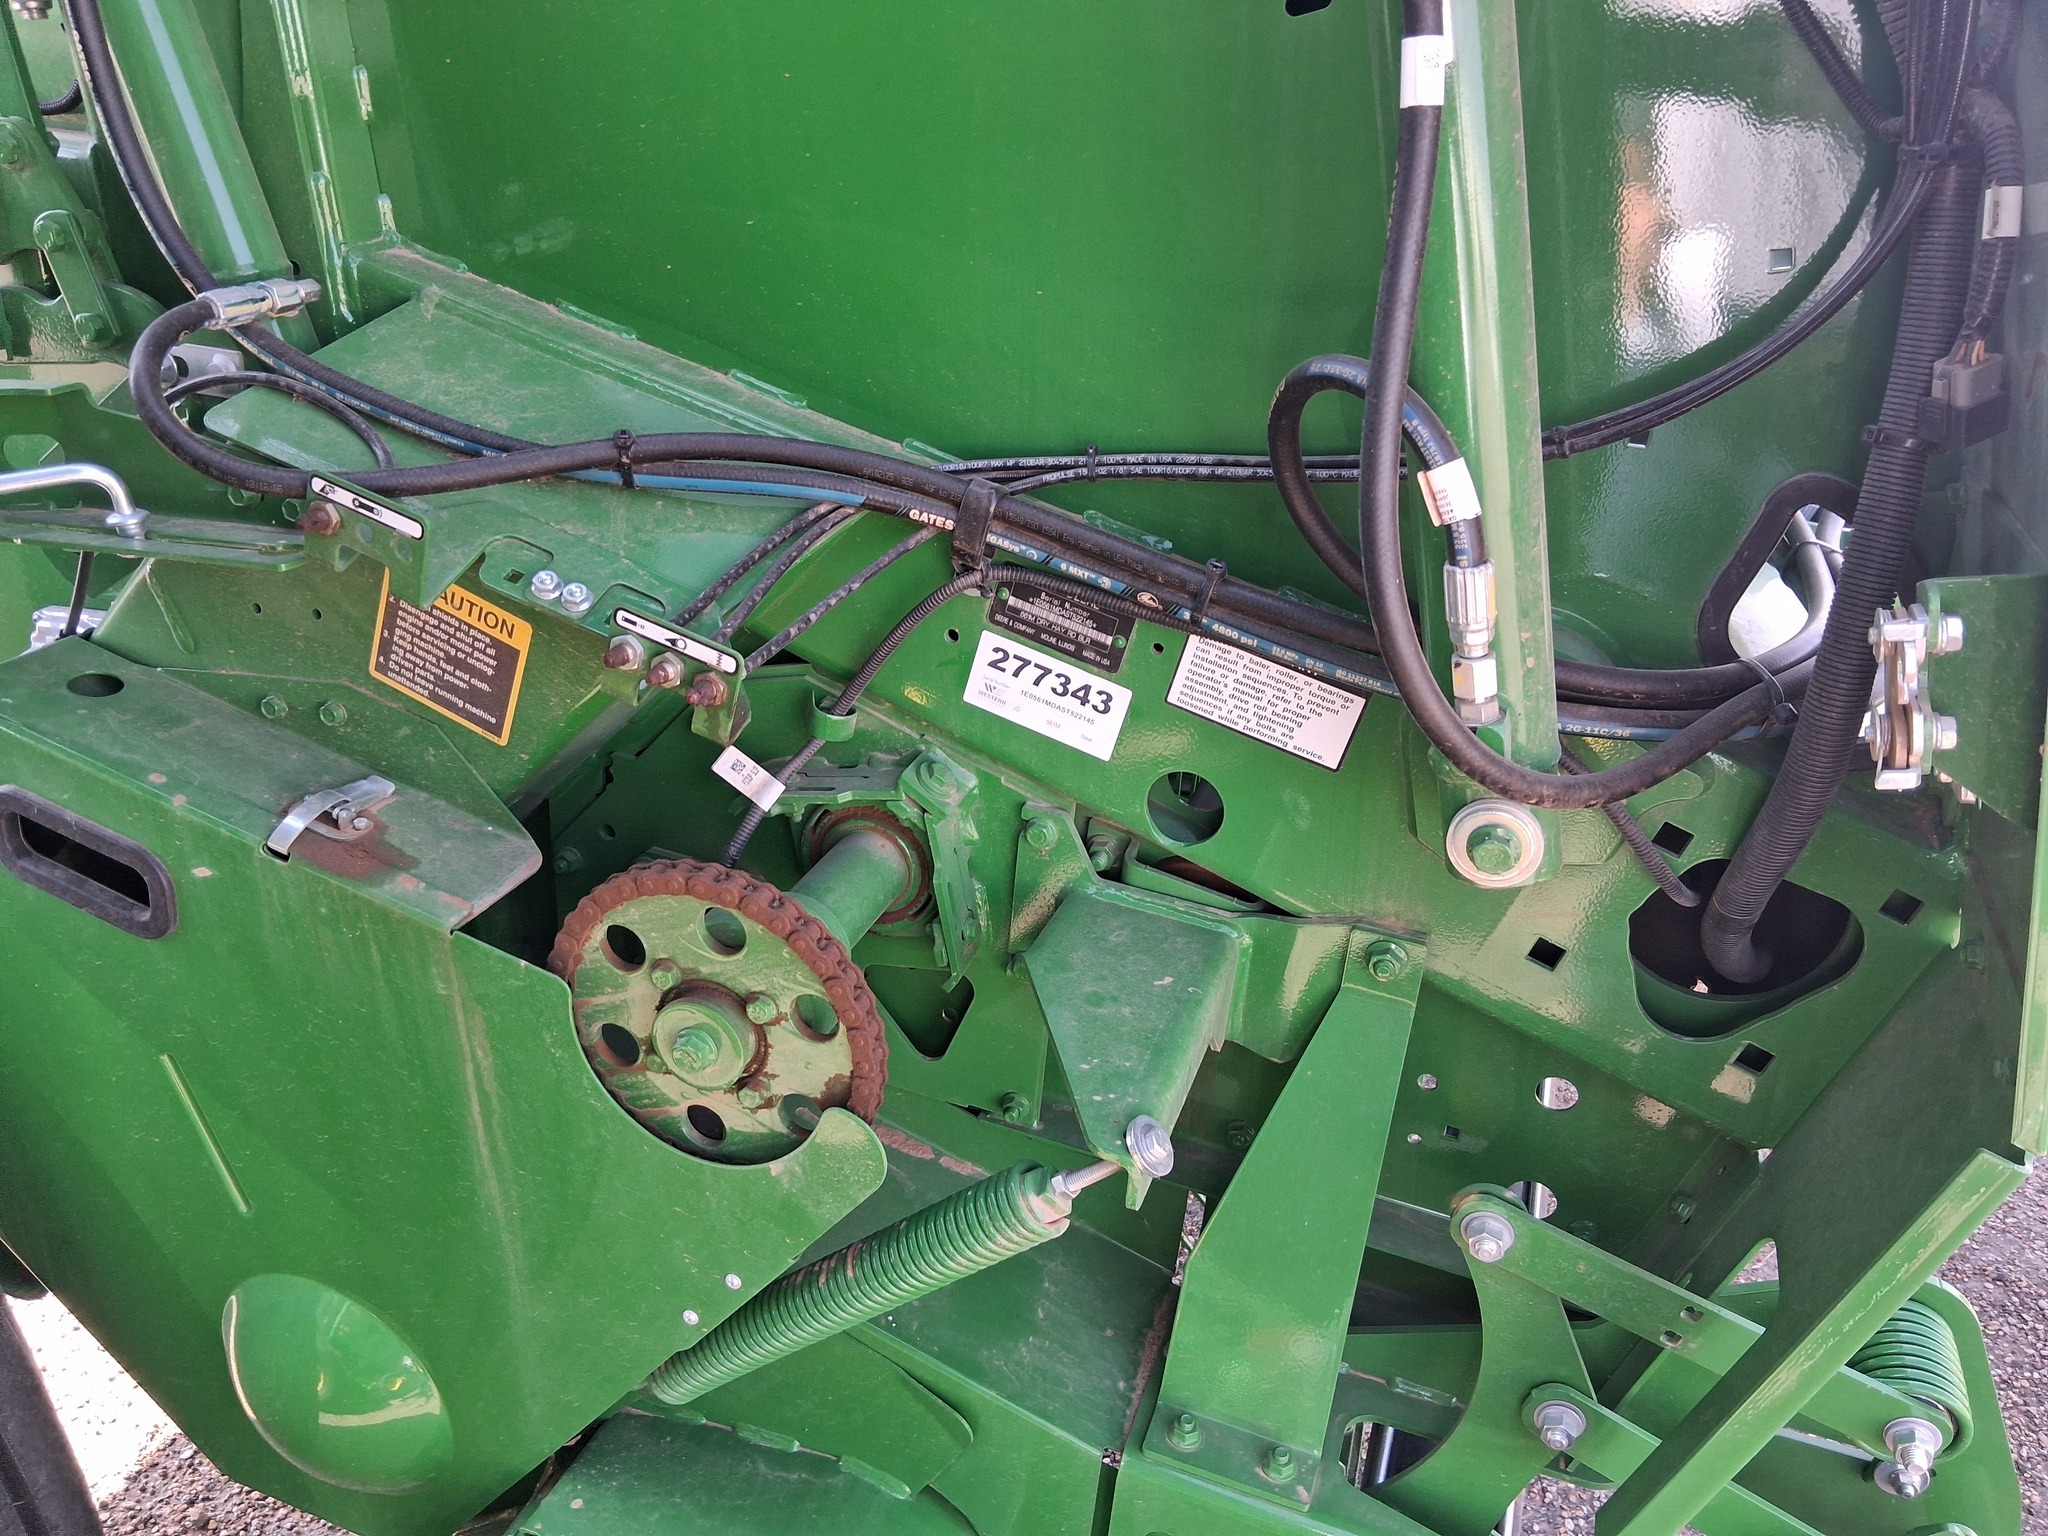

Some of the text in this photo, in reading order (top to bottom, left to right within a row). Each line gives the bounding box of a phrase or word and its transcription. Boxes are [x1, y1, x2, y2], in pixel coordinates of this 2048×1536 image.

[1126, 455, 1144, 463] MADE
[1130, 466, 1143, 474] SAE
[1198, 468, 1213, 476] MAX
[908, 508, 956, 531] GATES
[399, 599, 439, 626] Disengage
[439, 622, 455, 635] and
[455, 630, 473, 645] shut
[473, 640, 486, 651] off
[485, 646, 496, 657] all
[431, 608, 492, 645] shields in place.
[440, 591, 515, 639] AUTION
[1035, 616, 1051, 628] DRY
[1050, 623, 1067, 635] HAY
[1066, 628, 1077, 639] RD
[1040, 591, 1061, 606] Serial
[1063, 601, 1090, 617] Number
[394, 627, 446, 659] ging machine.
[396, 617, 495, 676] before servicing or unclog-
[397, 609, 498, 667] engine and/or motor power
[994, 612, 1009, 625] DEERE
[1013, 621, 1036, 635] COMPANY
[1081, 649, 1096, 660] MADE
[1094, 654, 1101, 662] IN
[1100, 657, 1111, 666] USA
[1211, 623, 1239, 640] 4800
[382, 628, 492, 692] 3. Keep hands, feet and cloth-
[387, 670, 430, 698] unattended.
[389, 653, 436, 682] driven parts.
[391, 643, 470, 689] ing away from power-
[988, 647, 1112, 714] 277343
[1192, 652, 1340, 716] installation sequences. To prevent
[1194, 645, 1350, 711] can result from improper torque or
[1198, 637, 1355, 704] Damage to baler, roller, or bearings
[378, 655, 497, 724] 4. Do not leave running machine
[977, 689, 1007, 706] WESTERN
[1020, 689, 1095, 725] 1E0561MDAST522145
[1181, 683, 1295, 734] adjustment, and tightening
[1184, 675, 1303, 728] assembly, drive roll bearing
[1187, 668, 1311, 721] operator's manual for proper
[1189, 659, 1323, 718] failure or damage, refer to the
[1176, 696, 1324, 762] loosened while performing service.
[1179, 690, 1295, 741] sequences if any bolts are
